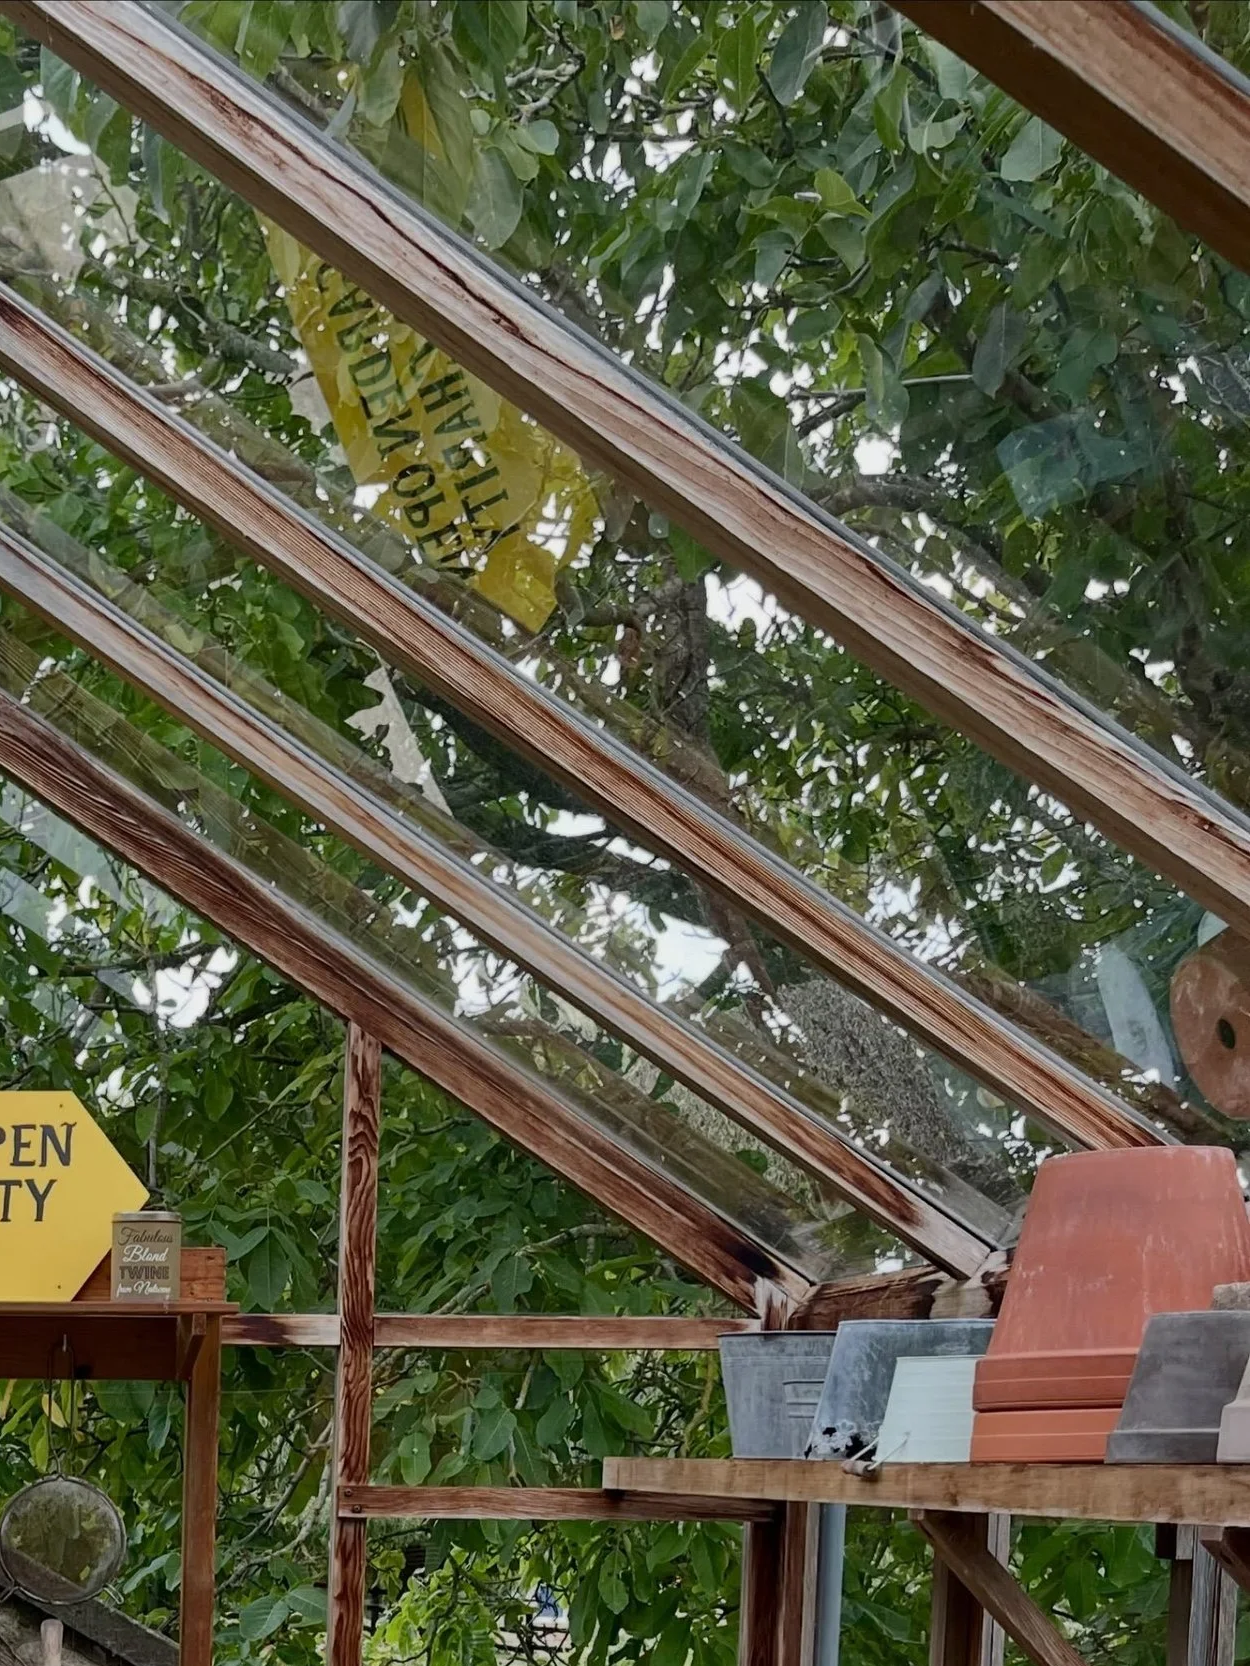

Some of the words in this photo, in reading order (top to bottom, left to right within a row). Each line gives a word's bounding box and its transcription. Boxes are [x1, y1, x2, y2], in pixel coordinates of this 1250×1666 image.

[117, 1226, 174, 1246] Fabulous
[122, 1244, 170, 1262] Blond
[118, 1265, 170, 1280] TWINE
